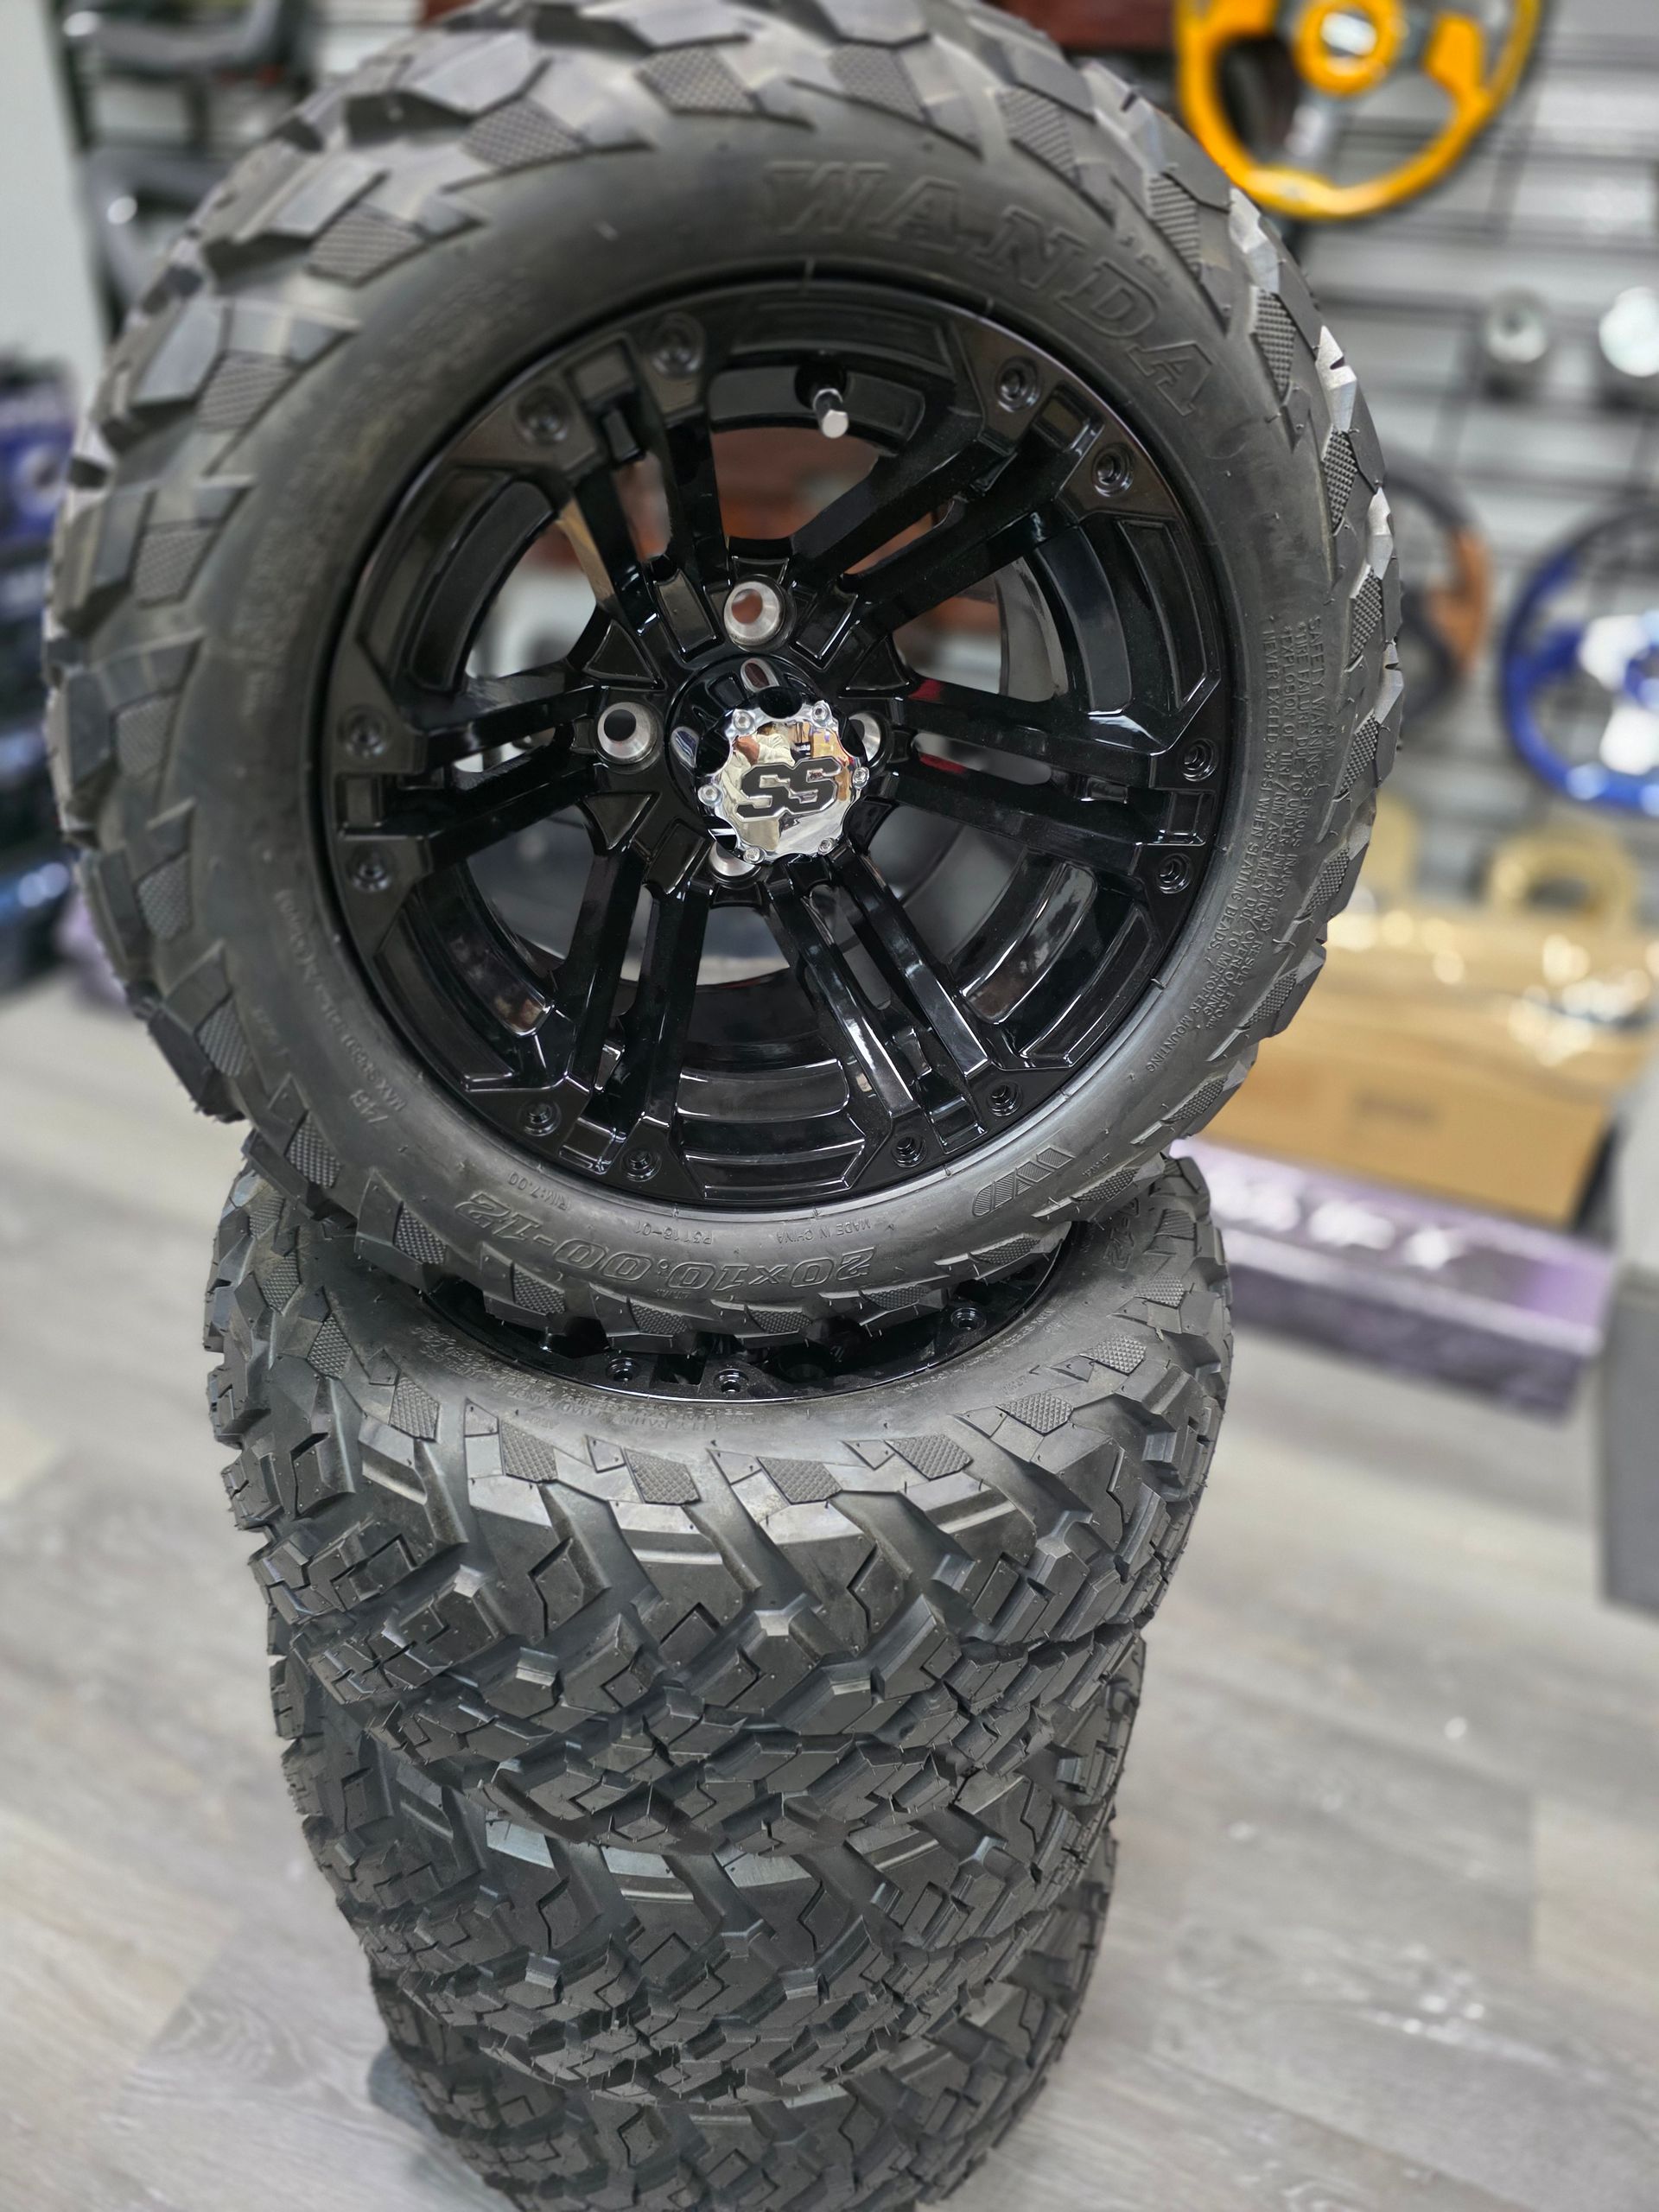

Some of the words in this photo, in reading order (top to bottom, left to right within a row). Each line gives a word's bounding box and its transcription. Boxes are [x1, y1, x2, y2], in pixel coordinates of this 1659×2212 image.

[766, 161, 1213, 416] WANDA
[1262, 629, 1280, 680] NEVER
[1306, 616, 1326, 688] SAFETY
[1266, 685, 1280, 742] EXCEED
[1296, 668, 1312, 728] FAILURE
[1283, 724, 1294, 742] OF
[1294, 736, 1308, 765] DUE
[736, 756, 842, 821] SS
[1289, 772, 1304, 791] TO
[1250, 796, 1270, 837] WHEN
[1230, 842, 1260, 902] SEATING
[1249, 820, 1281, 893] ASSEMBLY
[1272, 852, 1298, 903] INJURY
[1238, 896, 1257, 922] DUE
[1259, 906, 1280, 934] MAY
[1226, 928, 1243, 949] TO
[1231, 938, 1263, 988] RESULT
[1188, 950, 1233, 1015] IMPROPER
[1143, 1014, 1193, 1074] MOUNTING
[506, 1170, 571, 1212] RIM:7.00
[776, 1228, 814, 1243] CHINA
[819, 1226, 830, 1239] IN
[836, 1217, 872, 1236] MADE
